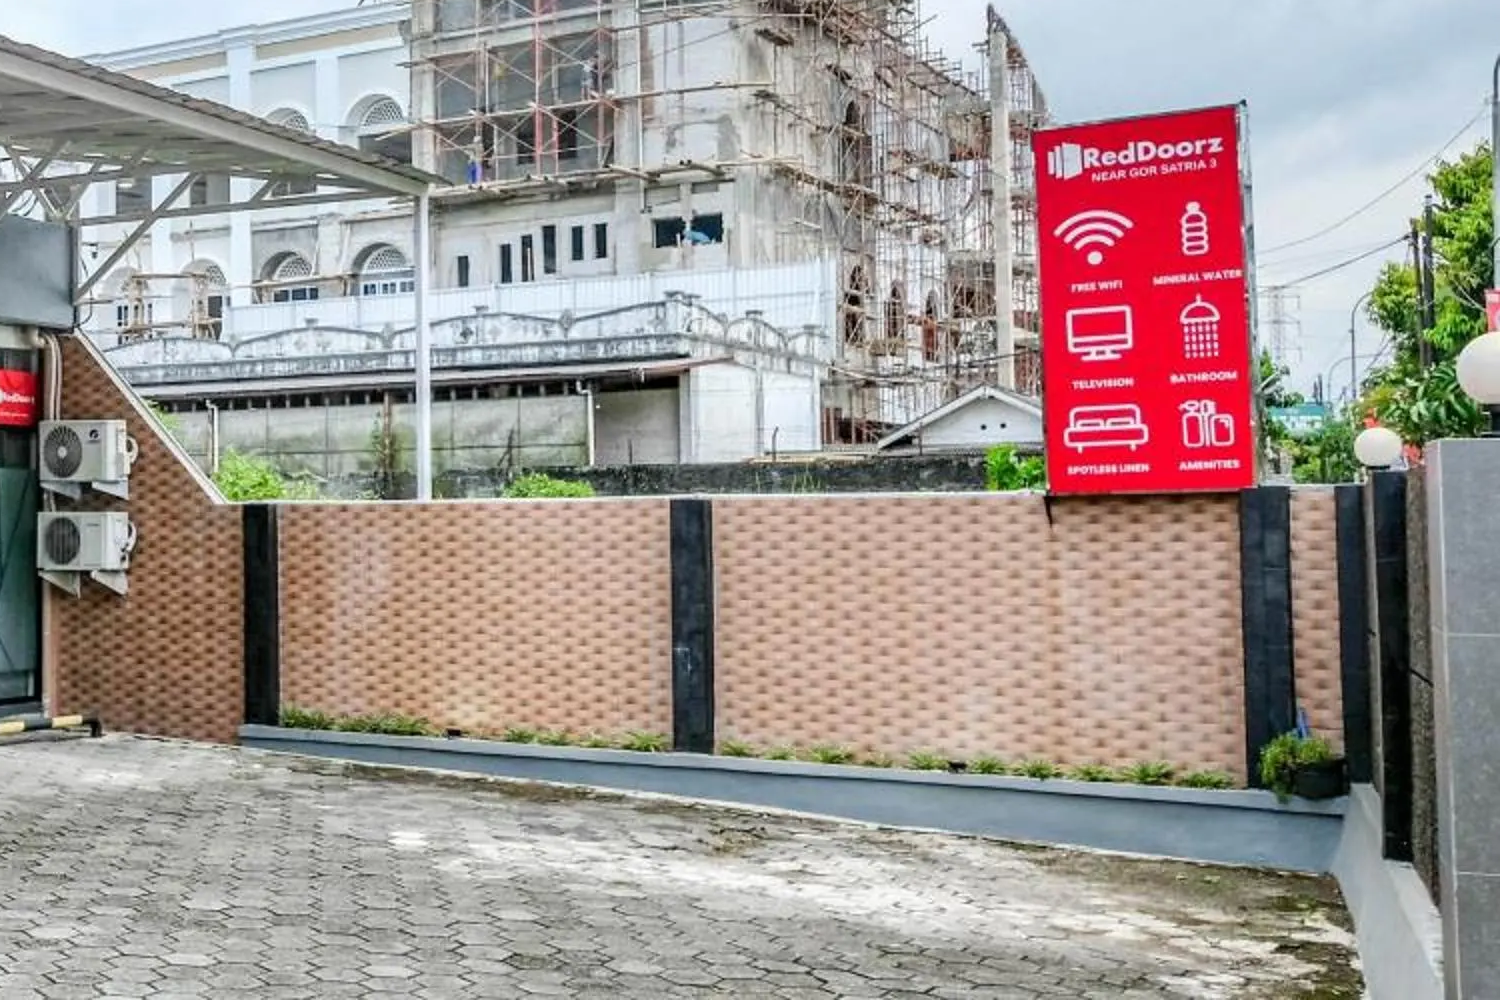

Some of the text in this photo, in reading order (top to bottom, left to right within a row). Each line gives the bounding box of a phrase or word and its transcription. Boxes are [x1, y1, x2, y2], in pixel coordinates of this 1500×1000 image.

[1084, 137, 1224, 169] RedDoorz
[1091, 157, 1218, 183] NEAR GOR SATRIA 3
[1152, 269, 1243, 286] MINERAL WATER
[1071, 281, 1097, 293] FREE
[1072, 377, 1134, 390] TELEVISION
[1170, 370, 1238, 384] BATHROOM
[1179, 459, 1241, 472] AMENITIES
